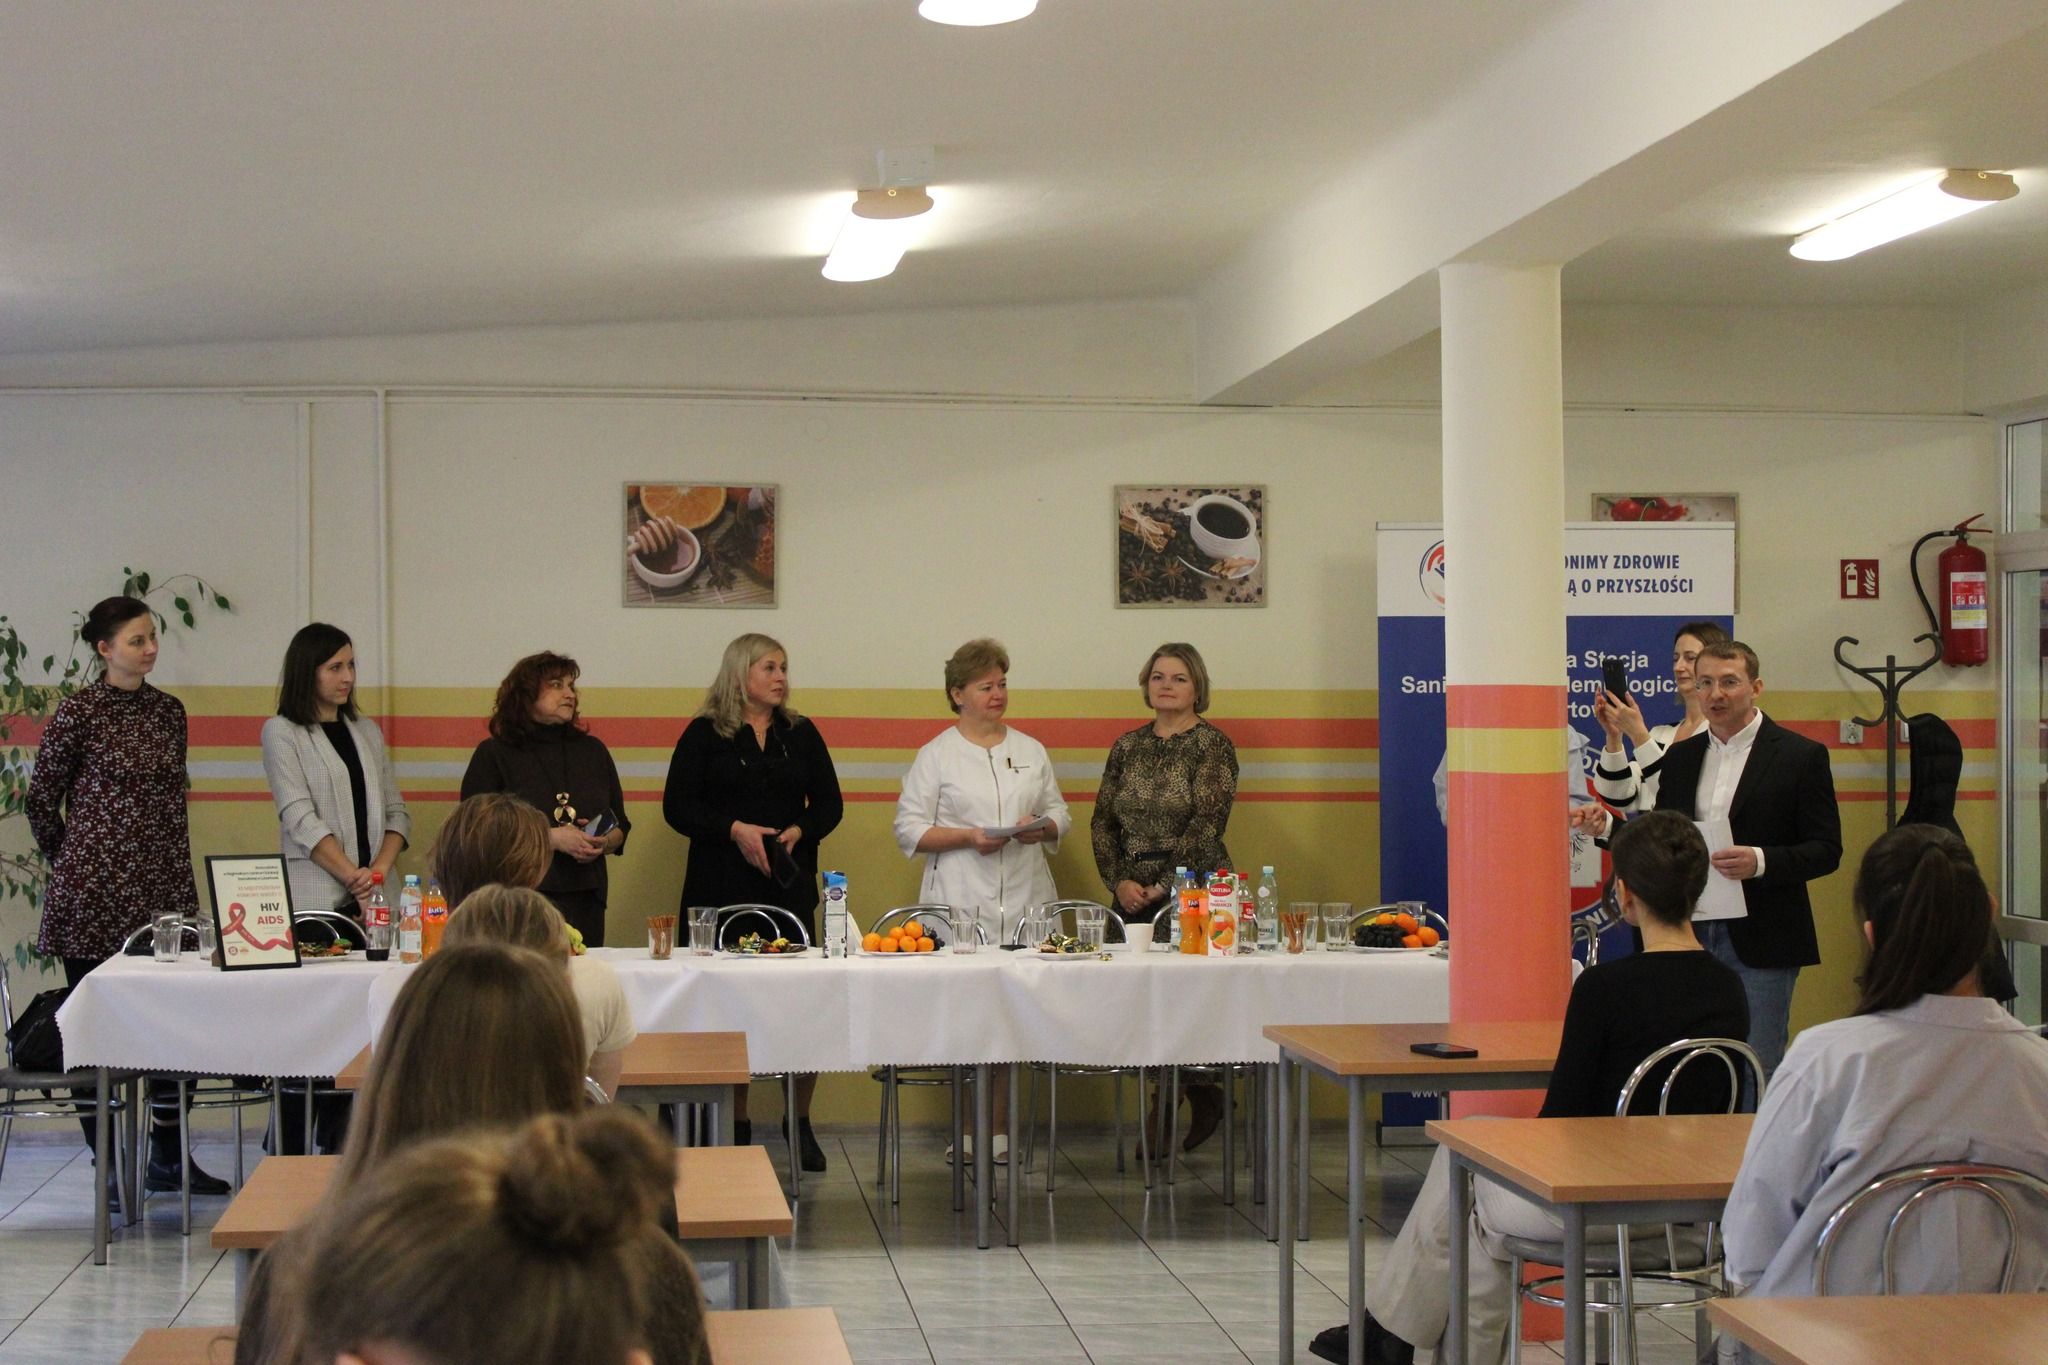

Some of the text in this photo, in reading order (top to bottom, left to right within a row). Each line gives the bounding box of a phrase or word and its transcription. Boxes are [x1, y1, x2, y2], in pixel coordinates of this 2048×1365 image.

[1613, 555, 1680, 569] ZDROWIE
[1566, 574, 1693, 597] Ą O PRZYSZŁOŚCI
[257, 915, 285, 925] AIDS
